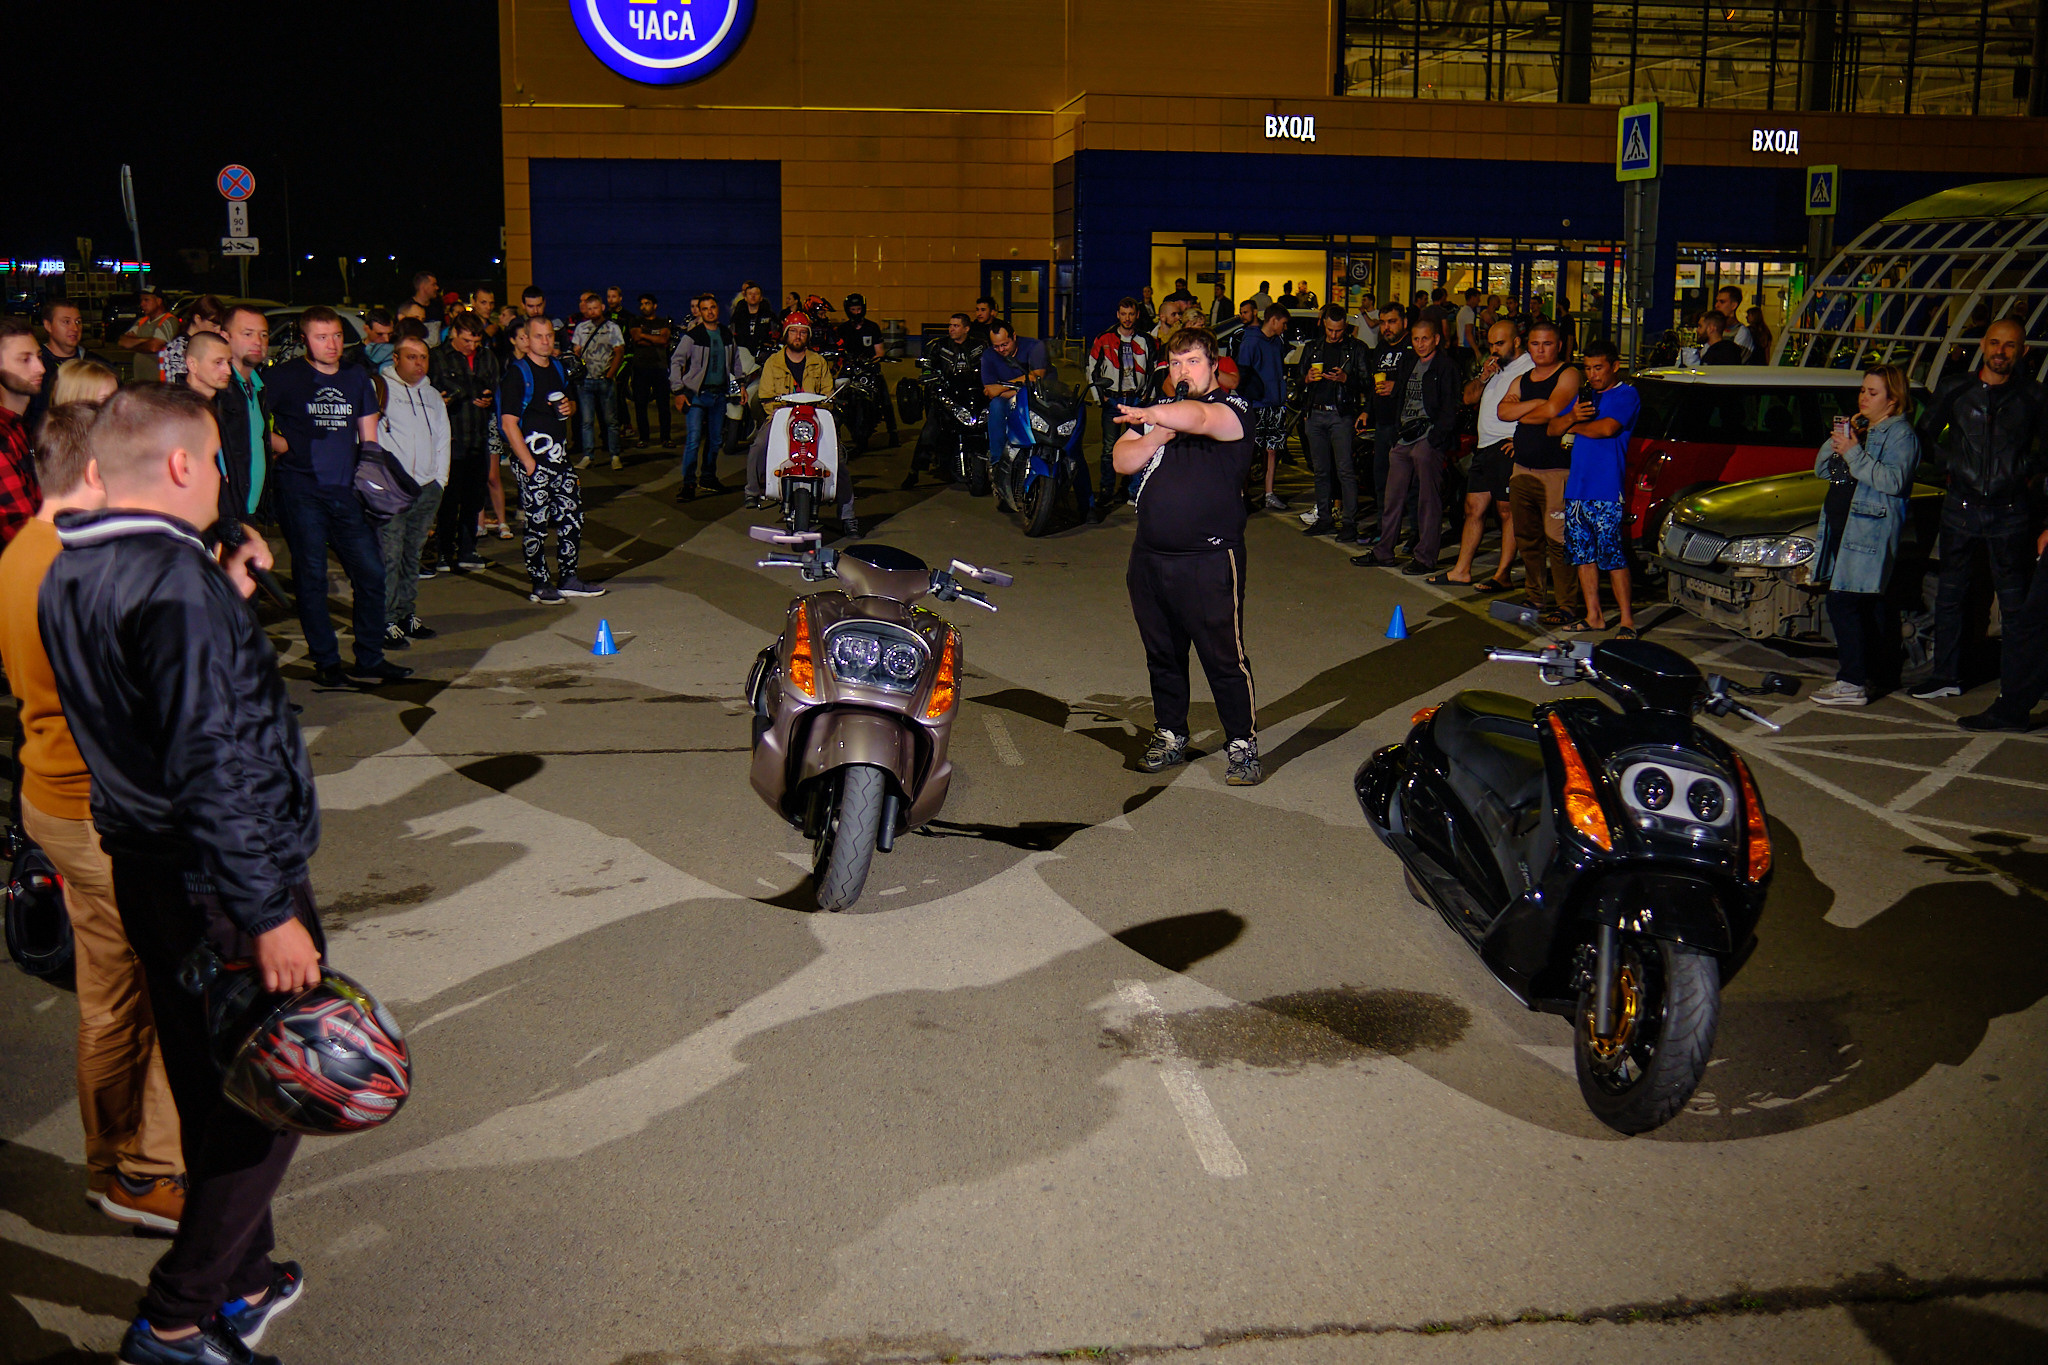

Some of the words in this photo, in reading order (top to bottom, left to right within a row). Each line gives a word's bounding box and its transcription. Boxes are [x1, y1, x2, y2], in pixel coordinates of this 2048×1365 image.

[629, 9, 696, 41] ЧАСА
[1265, 115, 1316, 142] ВХОД
[1752, 129, 1799, 155] ВХОД
[233, 218, 244, 226] 90
[307, 403, 353, 415] MUSTANG
